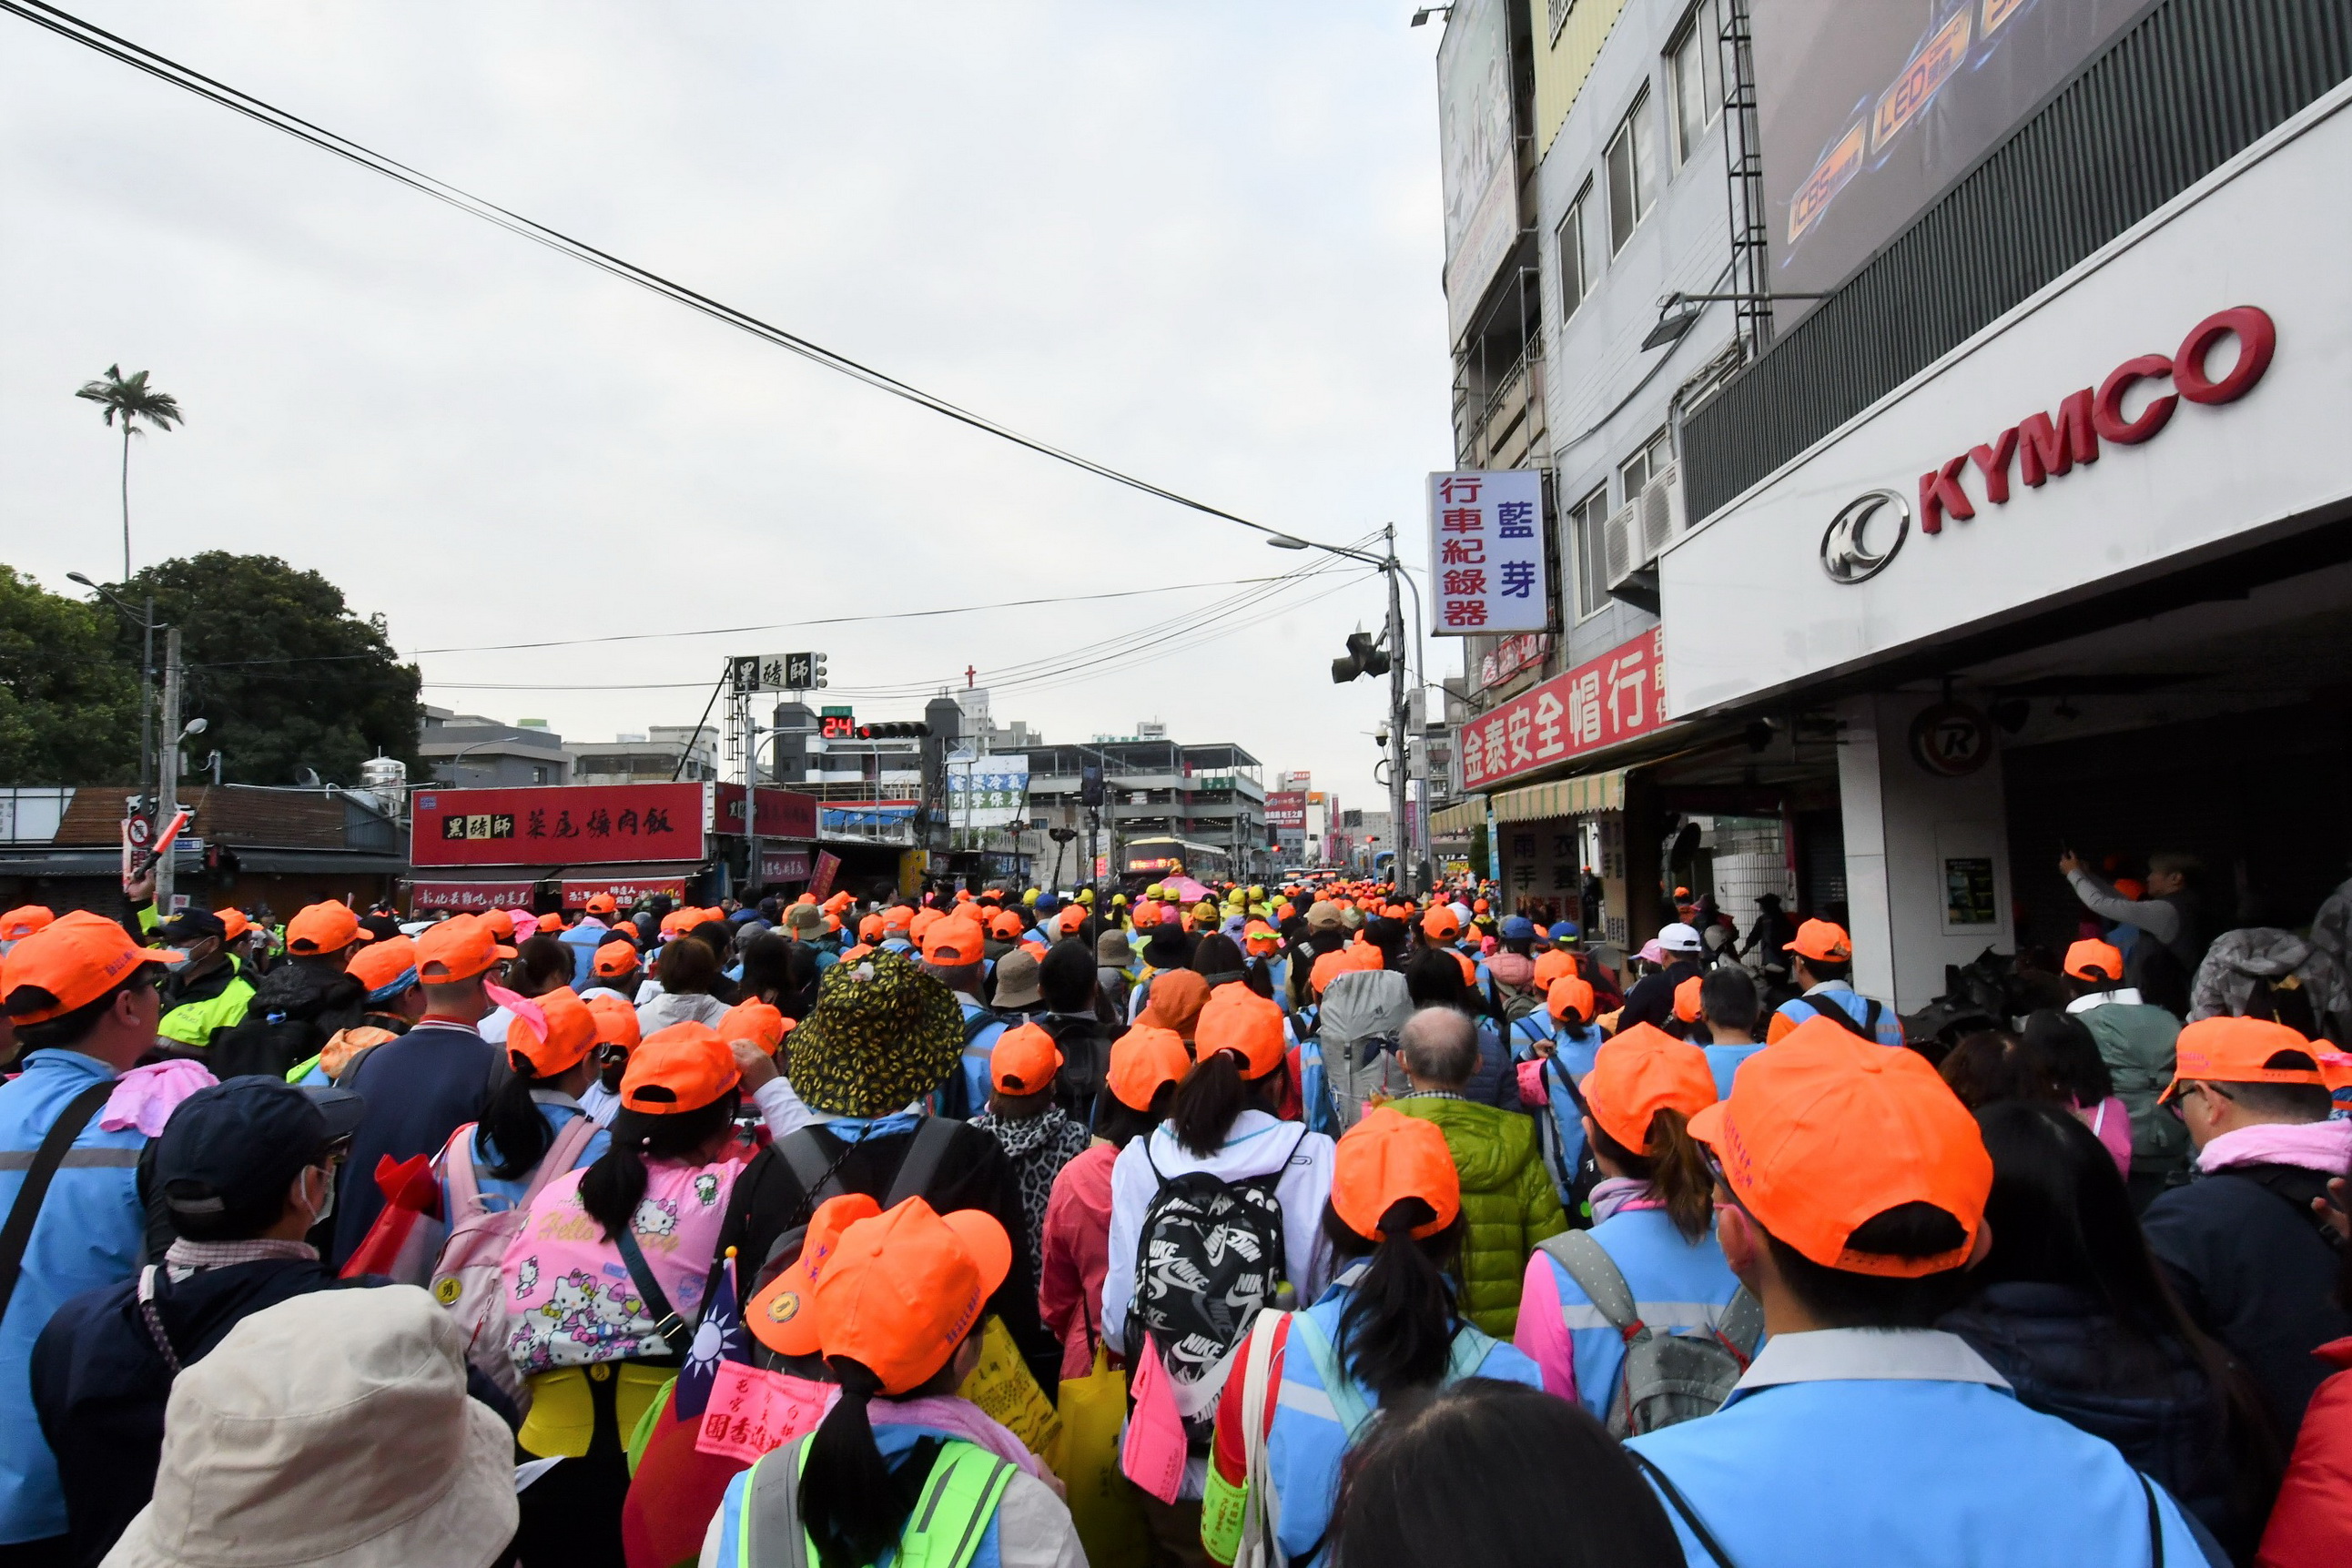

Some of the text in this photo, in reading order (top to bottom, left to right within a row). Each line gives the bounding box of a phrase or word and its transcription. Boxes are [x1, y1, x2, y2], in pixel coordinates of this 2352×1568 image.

[1881, 63, 1927, 136] LED
[1920, 306, 2276, 535] KYMCO
[1439, 476, 1489, 627] 行車紀錄器
[1497, 501, 1536, 599] 藍芽
[823, 717, 852, 738] 24
[1463, 649, 1648, 783] 金泰安全帽行
[1234, 1273, 1265, 1293] NIK
[1181, 1332, 1225, 1357] NIKE
